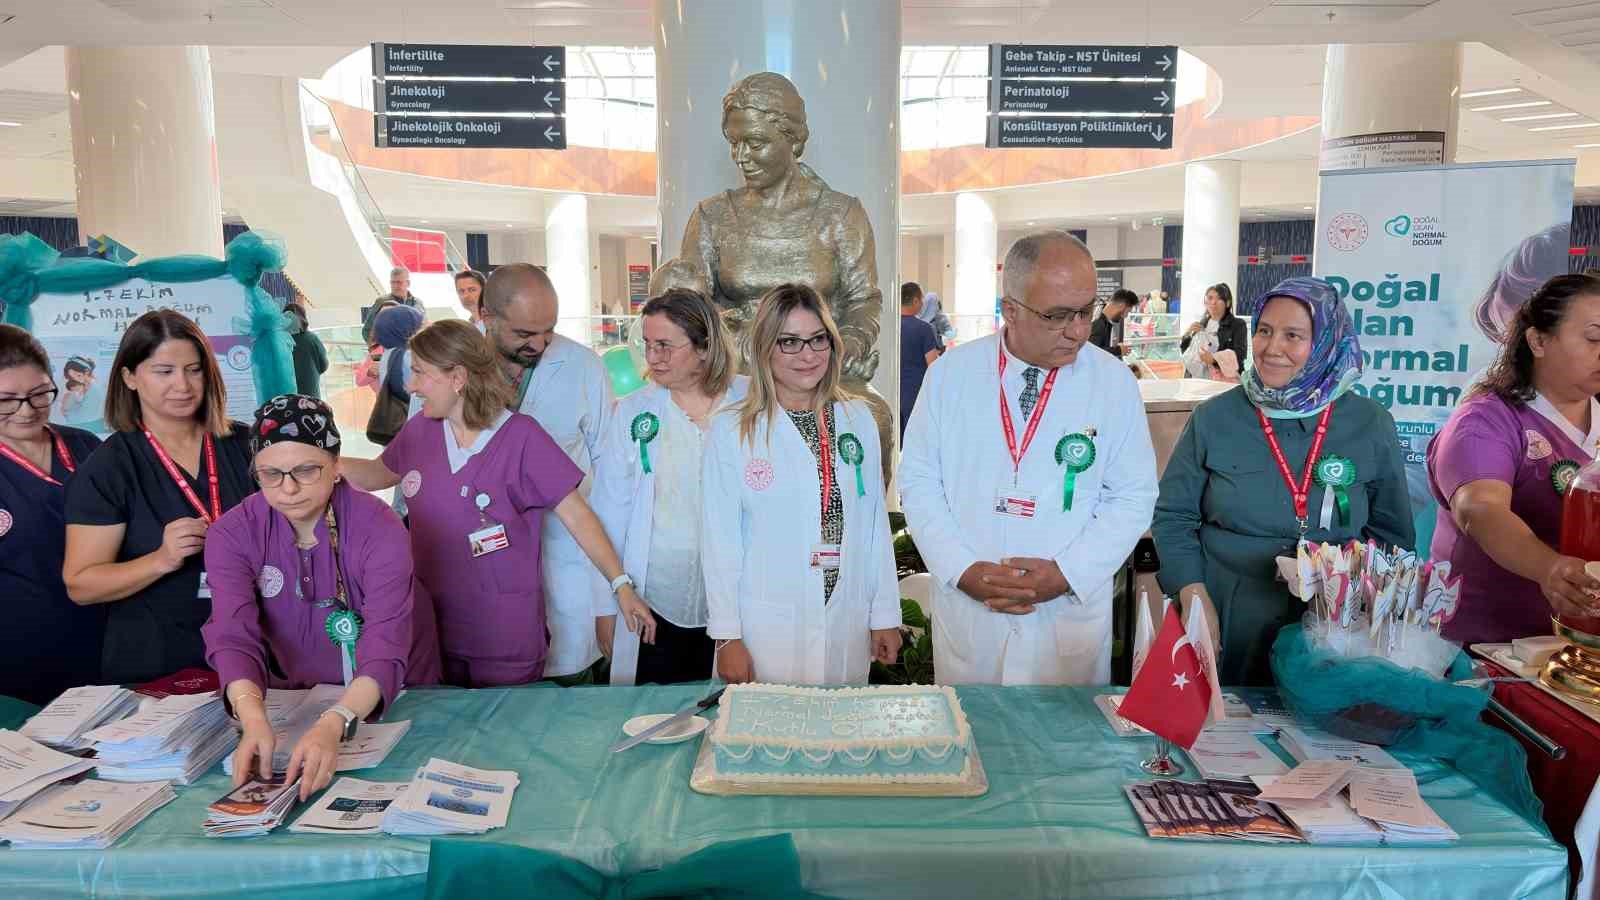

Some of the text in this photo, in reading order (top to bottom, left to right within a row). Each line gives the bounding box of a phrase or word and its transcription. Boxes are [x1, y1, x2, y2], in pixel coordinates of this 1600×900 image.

[389, 47, 445, 61] İnfertilite
[1005, 51, 1033, 61] Gebe
[1036, 51, 1066, 63] Takip
[1076, 52, 1099, 61] NST
[1102, 49, 1141, 62] Ünitesi
[389, 64, 424, 73] Infertility
[390, 85, 446, 98] Jinekoloji
[1004, 86, 1070, 98] Perinatoloji
[391, 121, 501, 135] Jinekolojik Onkoloji
[1003, 120, 1152, 133] Konsültasyon Poliklinikleri
[1325, 273, 1440, 308] Doğal
[1353, 309, 1413, 336] lan
[1362, 344, 1469, 372] rmal
[1352, 376, 1461, 410] oğum
[1396, 423, 1433, 434] orunlu
